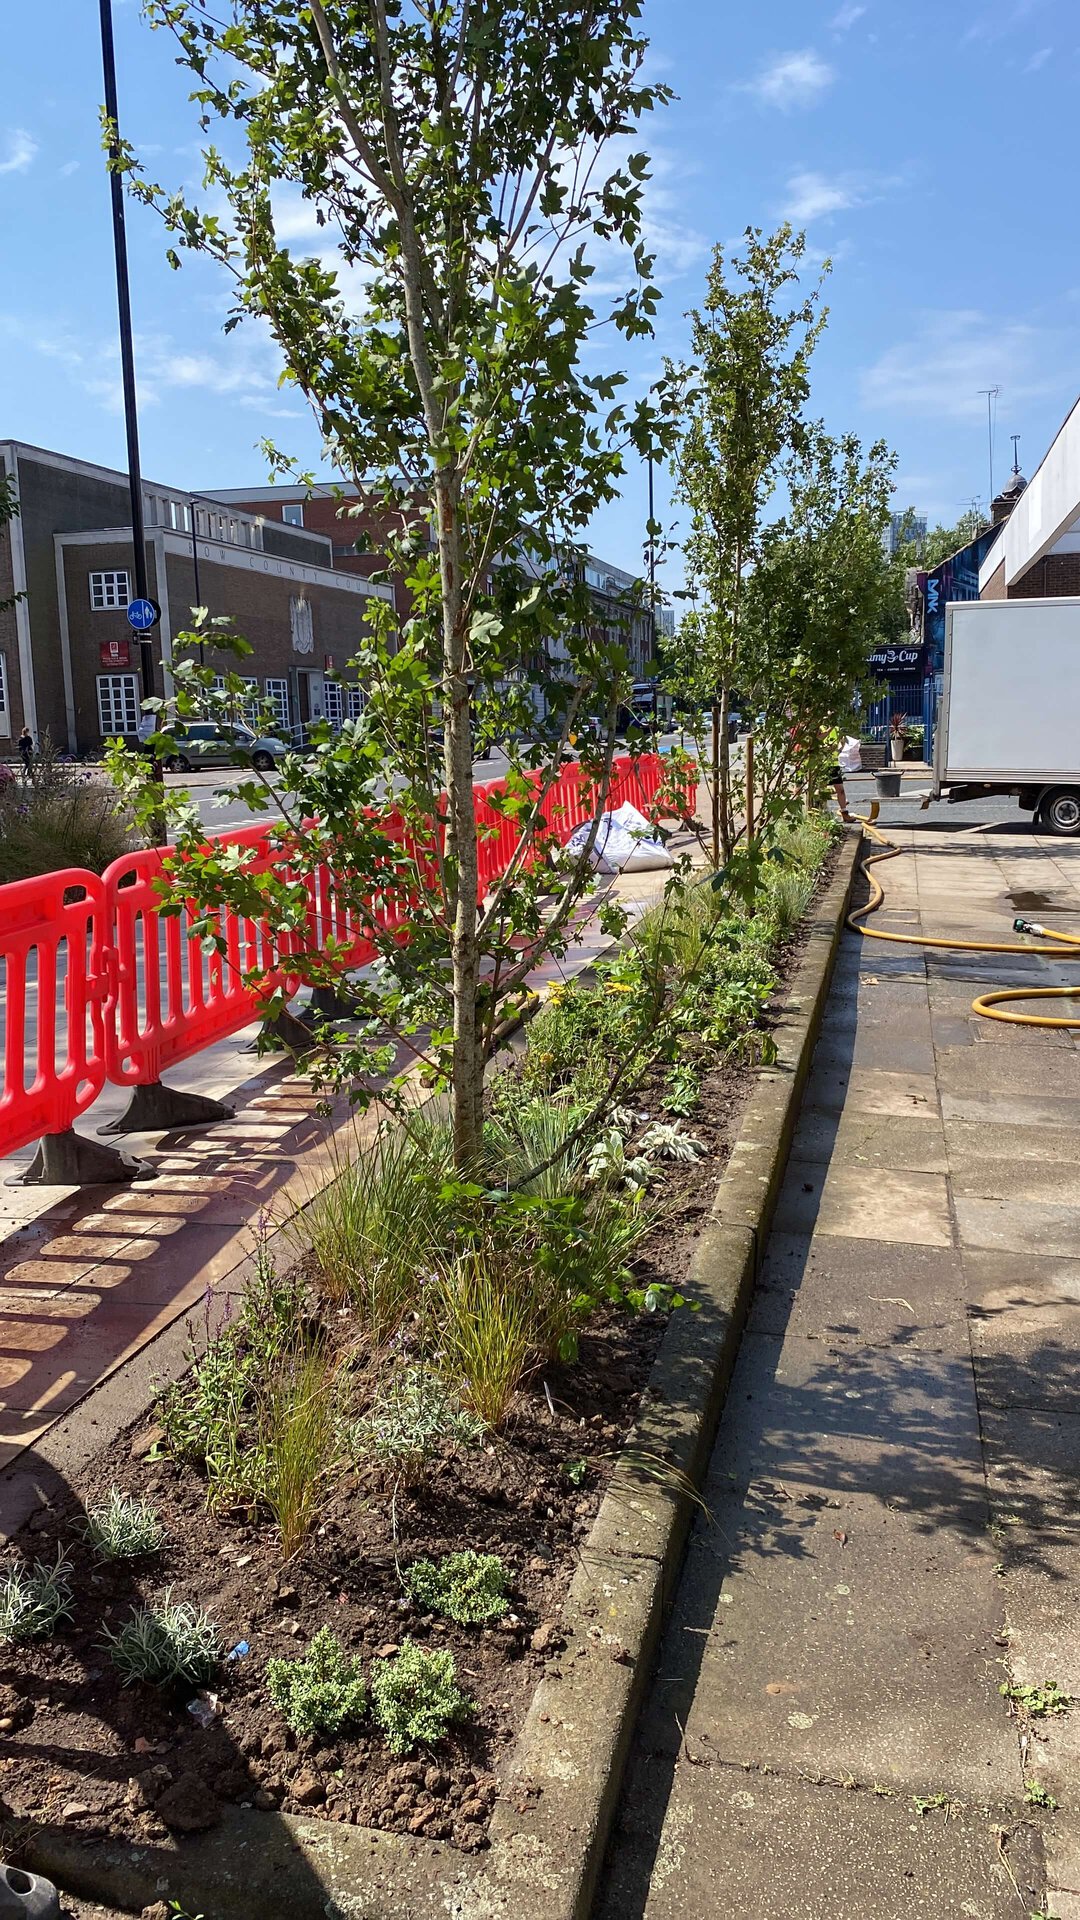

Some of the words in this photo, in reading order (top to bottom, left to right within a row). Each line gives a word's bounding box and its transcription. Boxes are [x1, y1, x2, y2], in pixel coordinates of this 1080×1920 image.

[189, 542, 225, 560] BOW
[250, 557, 318, 582] COUNTY
[899, 650, 918, 663] Cup
